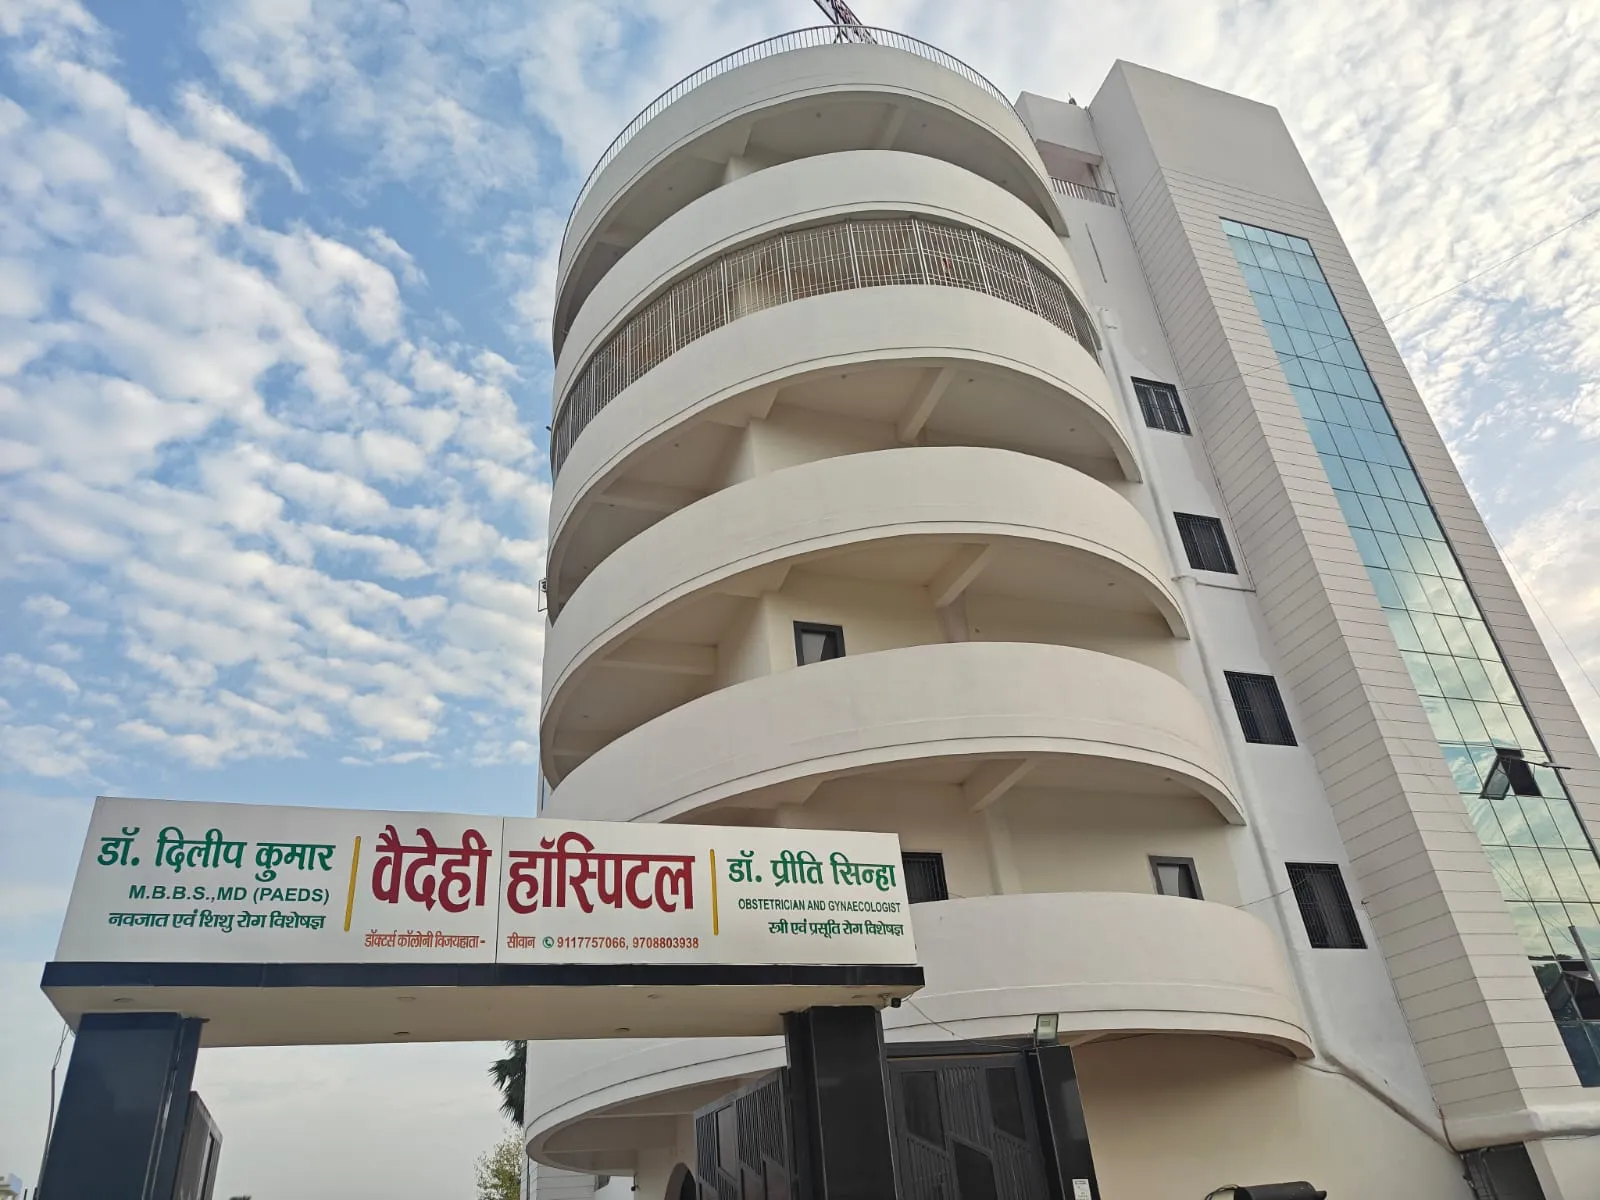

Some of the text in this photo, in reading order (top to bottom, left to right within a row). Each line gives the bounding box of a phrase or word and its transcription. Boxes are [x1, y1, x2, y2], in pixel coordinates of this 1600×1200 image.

[97, 826, 336, 882] डॉ. दिलीप कुमार
[371, 824, 696, 915] वैदेही हॉस्पिटल
[727, 850, 896, 891] डॉ. प्रीति सिन्हा
[252, 887, 330, 905] (PAEDS)
[738, 898, 901, 913] OBSTETRICIAN AND GYNAECOLOGIST
[108, 909, 326, 933] नवजात एवं शिशु रोग विशेषज्ञ
[768, 918, 904, 938] स्त्री एवं प्रसूति रोग विशेषज्ञ
[364, 929, 396, 948] डॉक्टर्स
[397, 930, 433, 948] कॉलोनी
[507, 932, 536, 949] सीवान
[557, 936, 629, 950] 9117757066,
[632, 937, 700, 949] 9708803938
